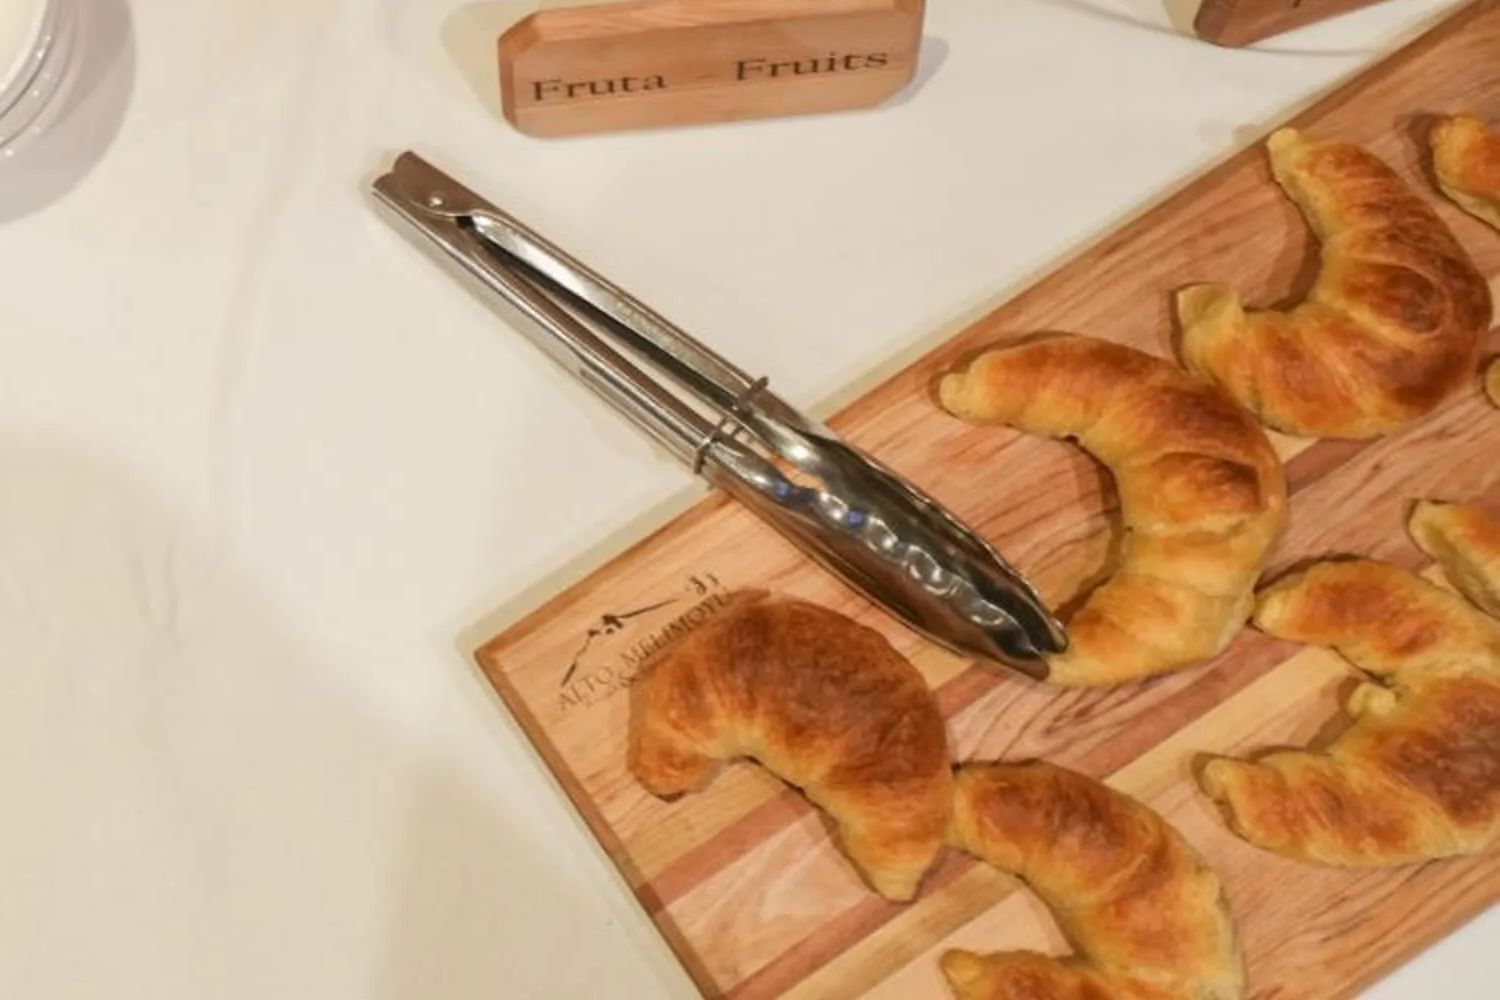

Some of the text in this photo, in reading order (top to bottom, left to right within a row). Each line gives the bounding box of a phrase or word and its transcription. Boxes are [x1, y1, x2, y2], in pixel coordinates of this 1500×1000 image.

[531, 74, 667, 101] Fruta
[732, 51, 889, 83] Fruits
[559, 666, 613, 711] ALTO
